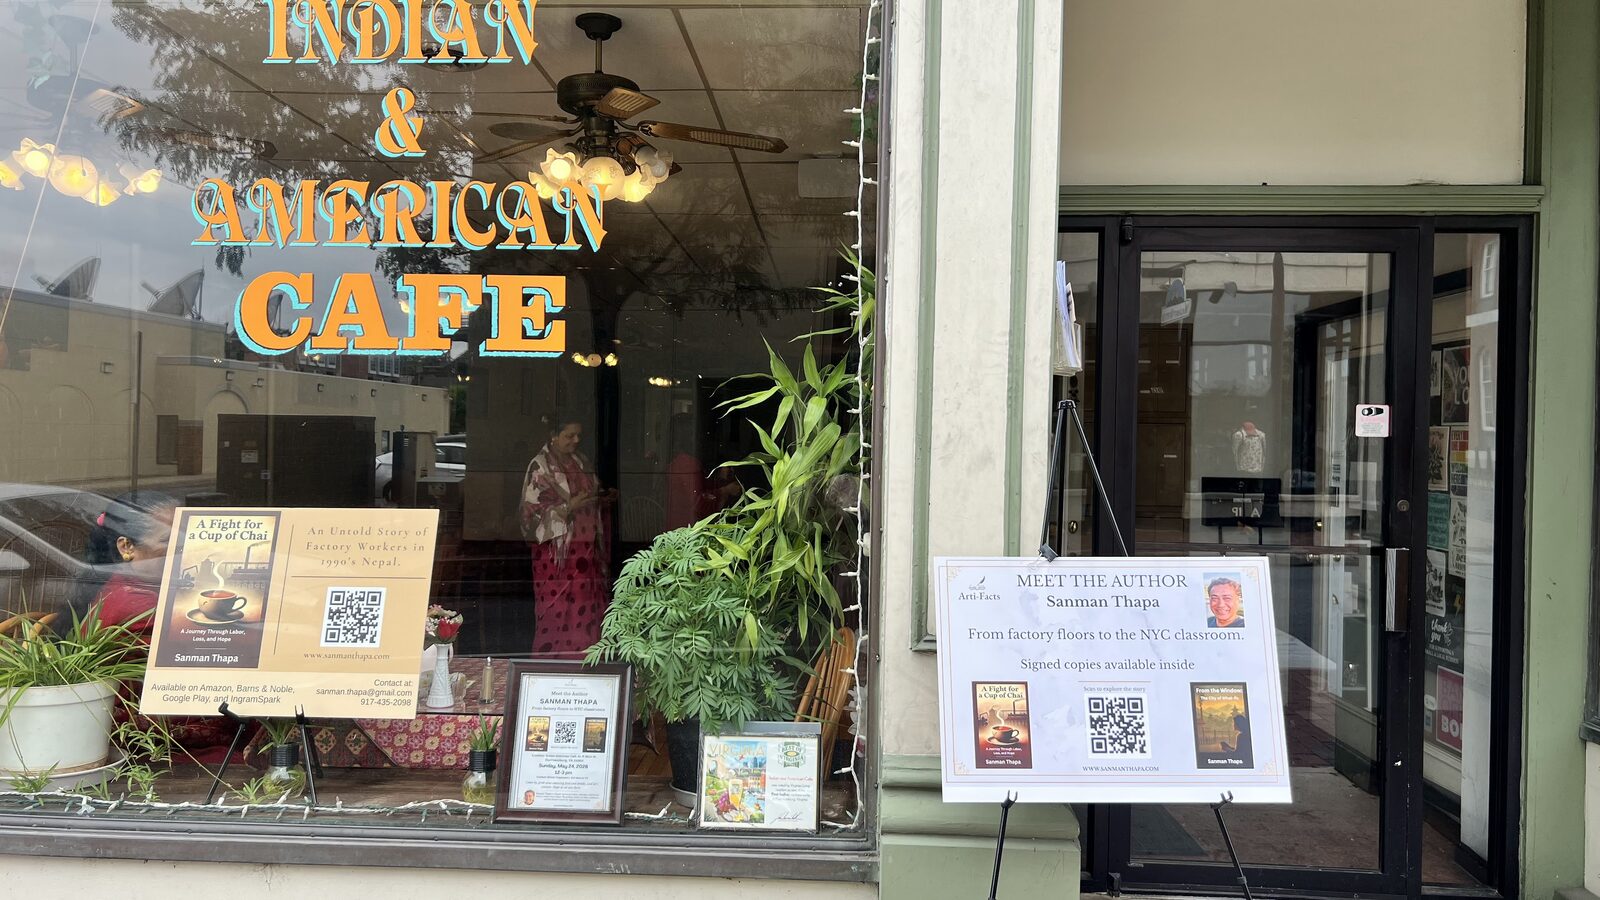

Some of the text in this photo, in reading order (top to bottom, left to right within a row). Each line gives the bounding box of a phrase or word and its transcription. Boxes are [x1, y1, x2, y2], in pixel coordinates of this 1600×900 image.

[262, 0, 539, 65] INDIAN
[375, 87, 427, 157] &
[191, 177, 609, 252] AMERICAN
[234, 271, 567, 356] CAFE
[196, 519, 263, 532] A Fight for
[188, 530, 268, 543] a Cup of Chai
[307, 526, 429, 539] An Untold Story of
[306, 541, 425, 554] Factory Workers in
[321, 556, 401, 569] 1990's Nepal.
[1016, 574, 1188, 588] MEET THE AUTHOR
[958, 592, 1001, 601] Arti-Facts
[1046, 595, 1160, 611] Sanman Thapa
[185, 628, 207, 636] Journey
[207, 628, 229, 636] Through
[968, 628, 1244, 643] From factory floors to the NYC classroom.
[174, 653, 239, 664] Sanman Thapa
[303, 651, 390, 662] www.sanmanthapa.com
[1020, 658, 1195, 672] Signed copies available inside
[151, 683, 187, 692] Available
[200, 684, 234, 693] Amazon,
[261, 684, 268, 693] &
[269, 685, 296, 694] Noble,
[374, 679, 413, 687] Contact at:
[162, 694, 281, 705] Google Play, and IngramSpark
[316, 688, 413, 698] sanman.thapa@gmail.com
[984, 692, 998, 700] Cup
[360, 698, 412, 706] 917-435-2098
